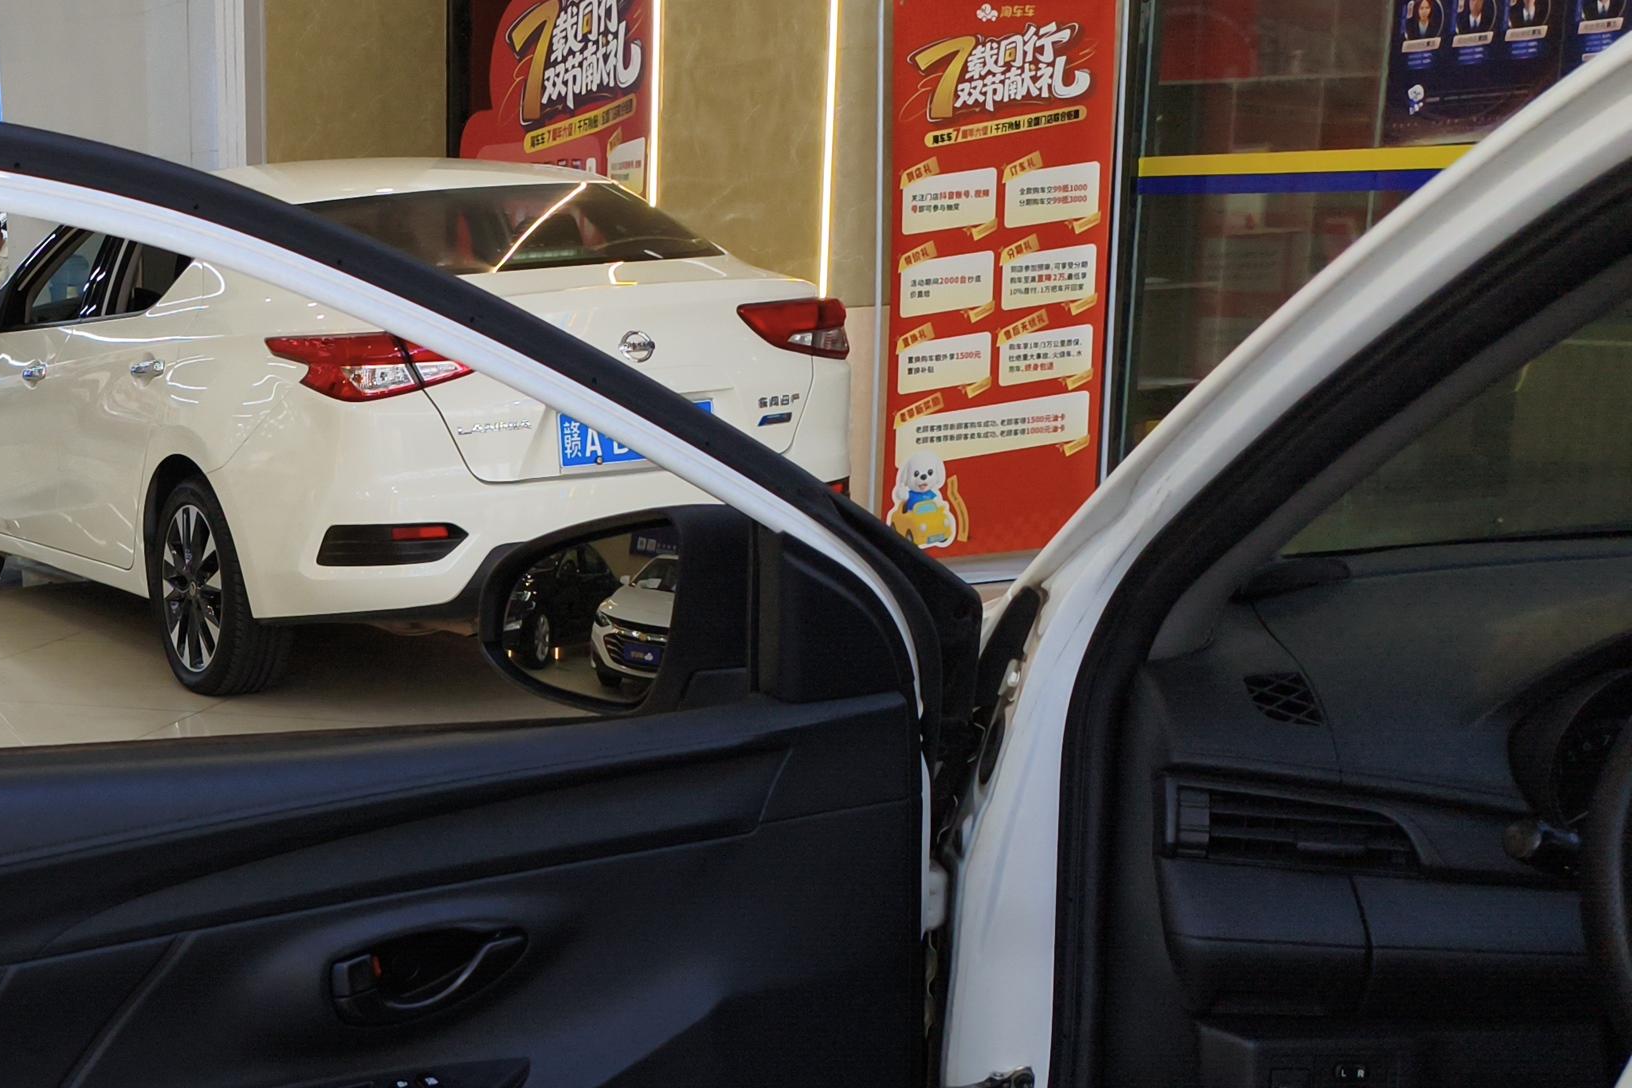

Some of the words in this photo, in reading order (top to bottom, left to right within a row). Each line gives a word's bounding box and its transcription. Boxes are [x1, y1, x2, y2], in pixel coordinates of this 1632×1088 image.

[542, 21, 641, 109] 双节献礼
[954, 56, 1090, 111] 双节献礼
